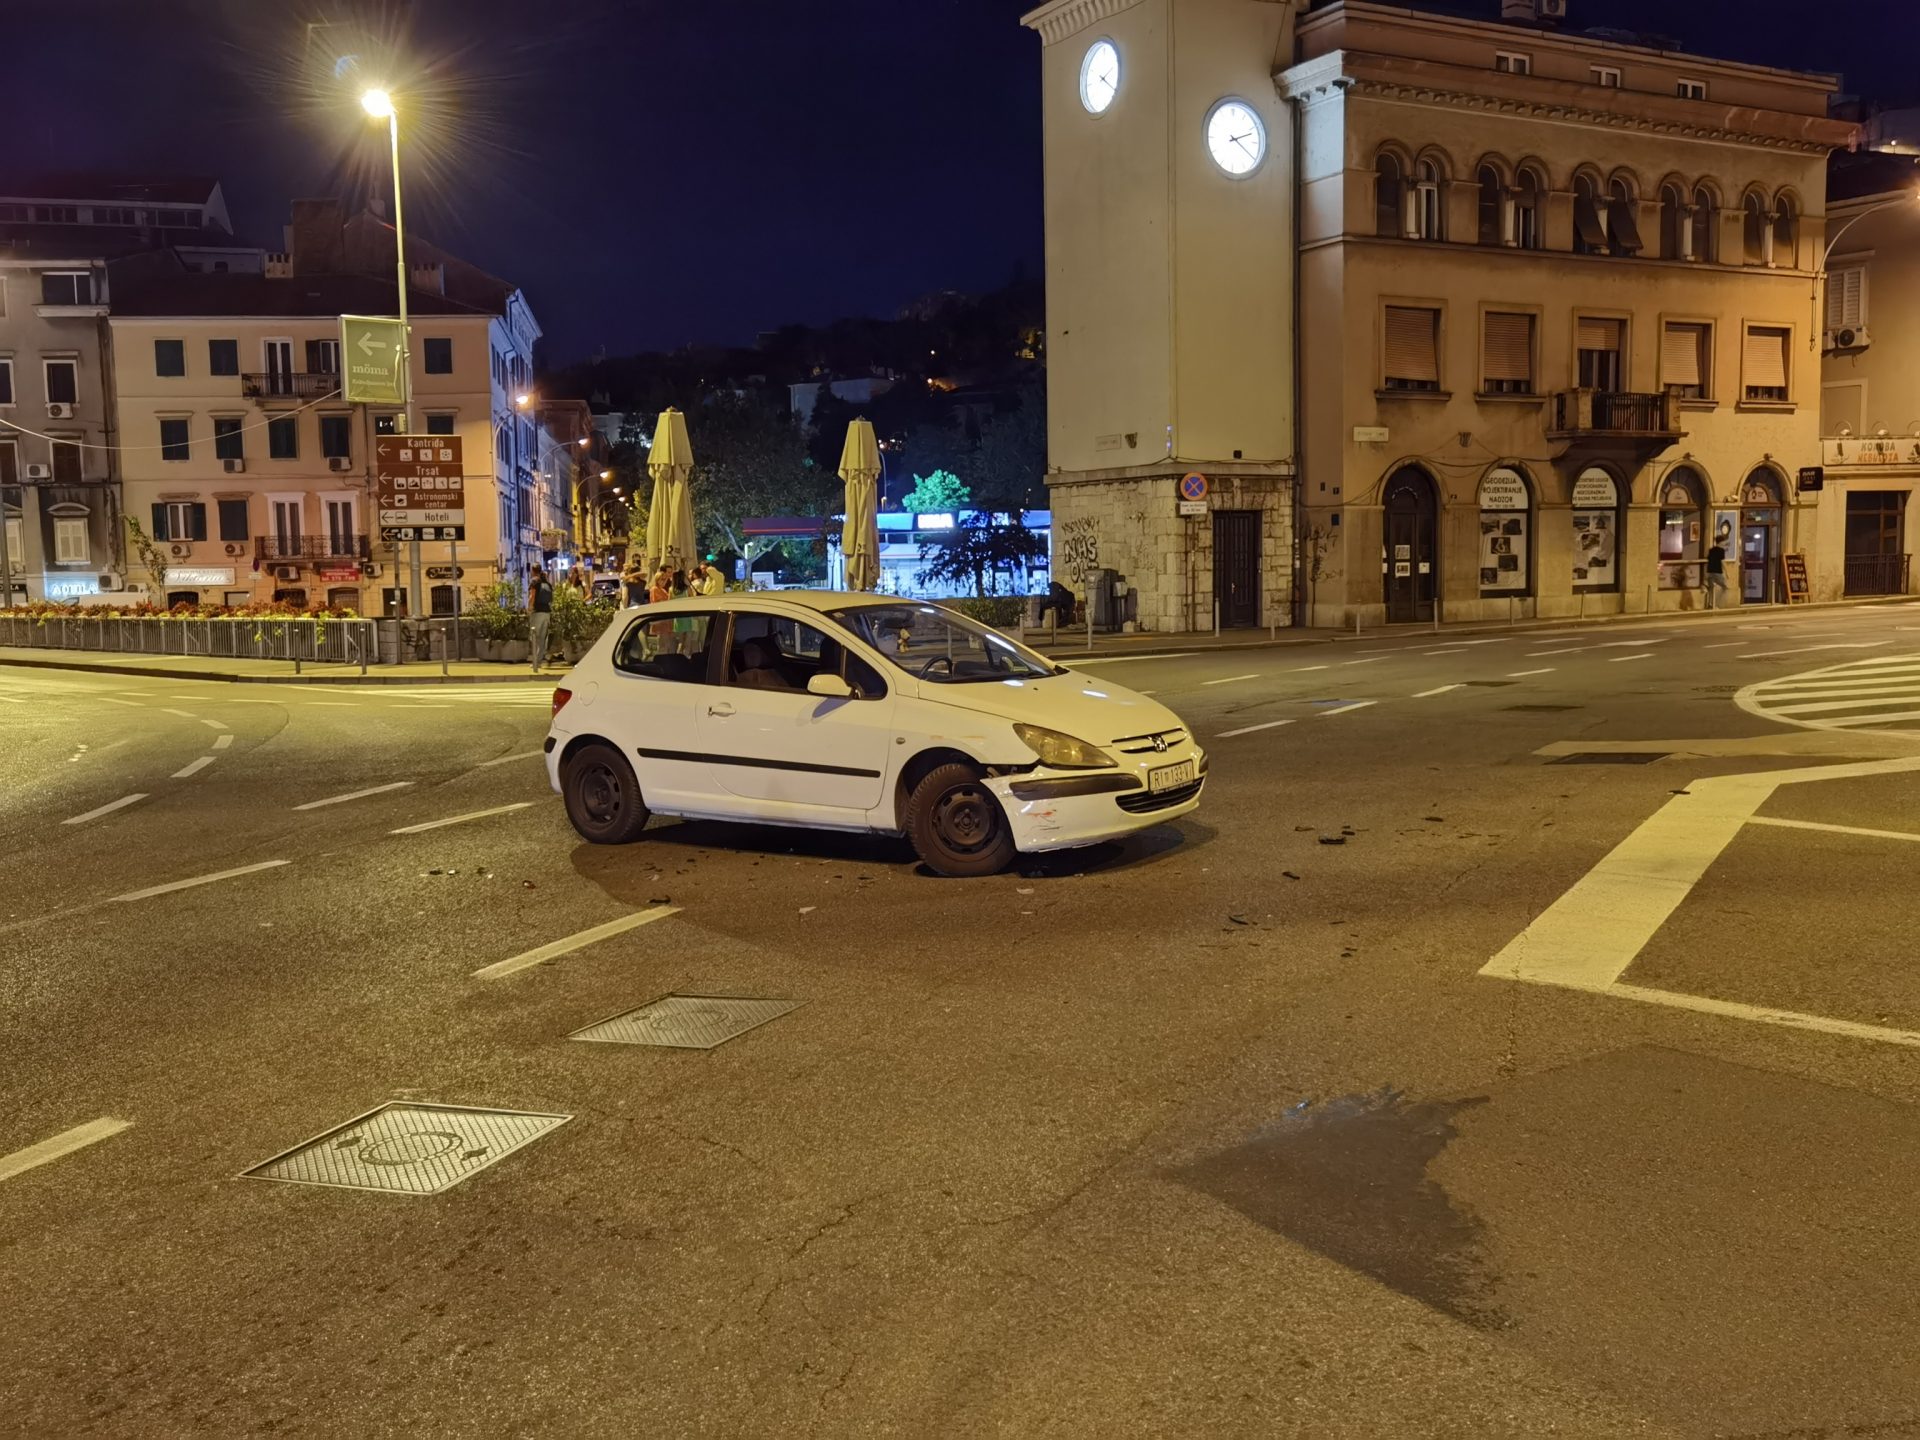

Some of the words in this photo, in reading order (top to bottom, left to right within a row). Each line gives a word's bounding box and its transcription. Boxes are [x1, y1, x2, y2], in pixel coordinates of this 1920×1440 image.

[416, 466, 439, 475] Trsat
[414, 493, 458, 501] Astronomski
[425, 512, 449, 521] Hoteli
